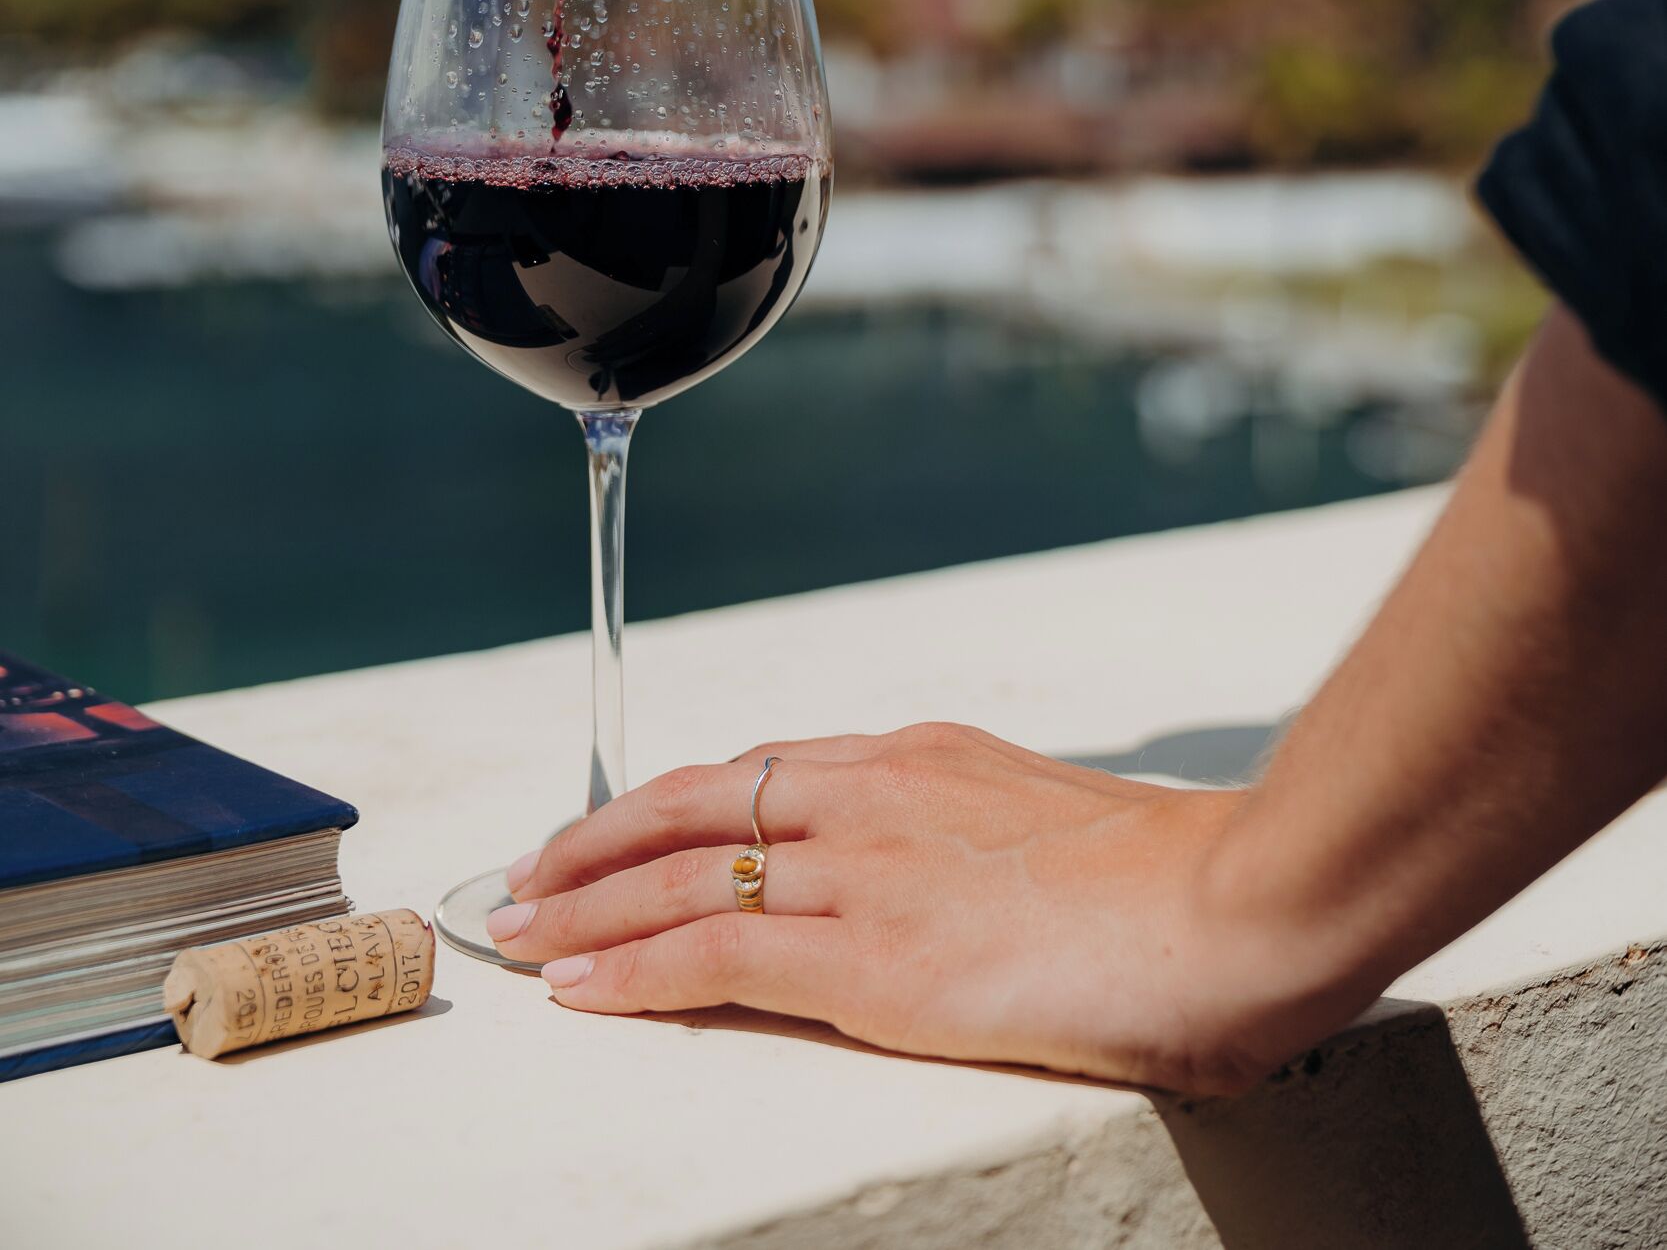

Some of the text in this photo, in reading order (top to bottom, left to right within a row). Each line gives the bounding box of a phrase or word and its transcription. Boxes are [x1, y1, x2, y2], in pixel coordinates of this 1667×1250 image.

[265, 941, 294, 1038] REDEROS
[300, 968, 326, 1031] RQUES
[398, 952, 421, 1007] 2017
